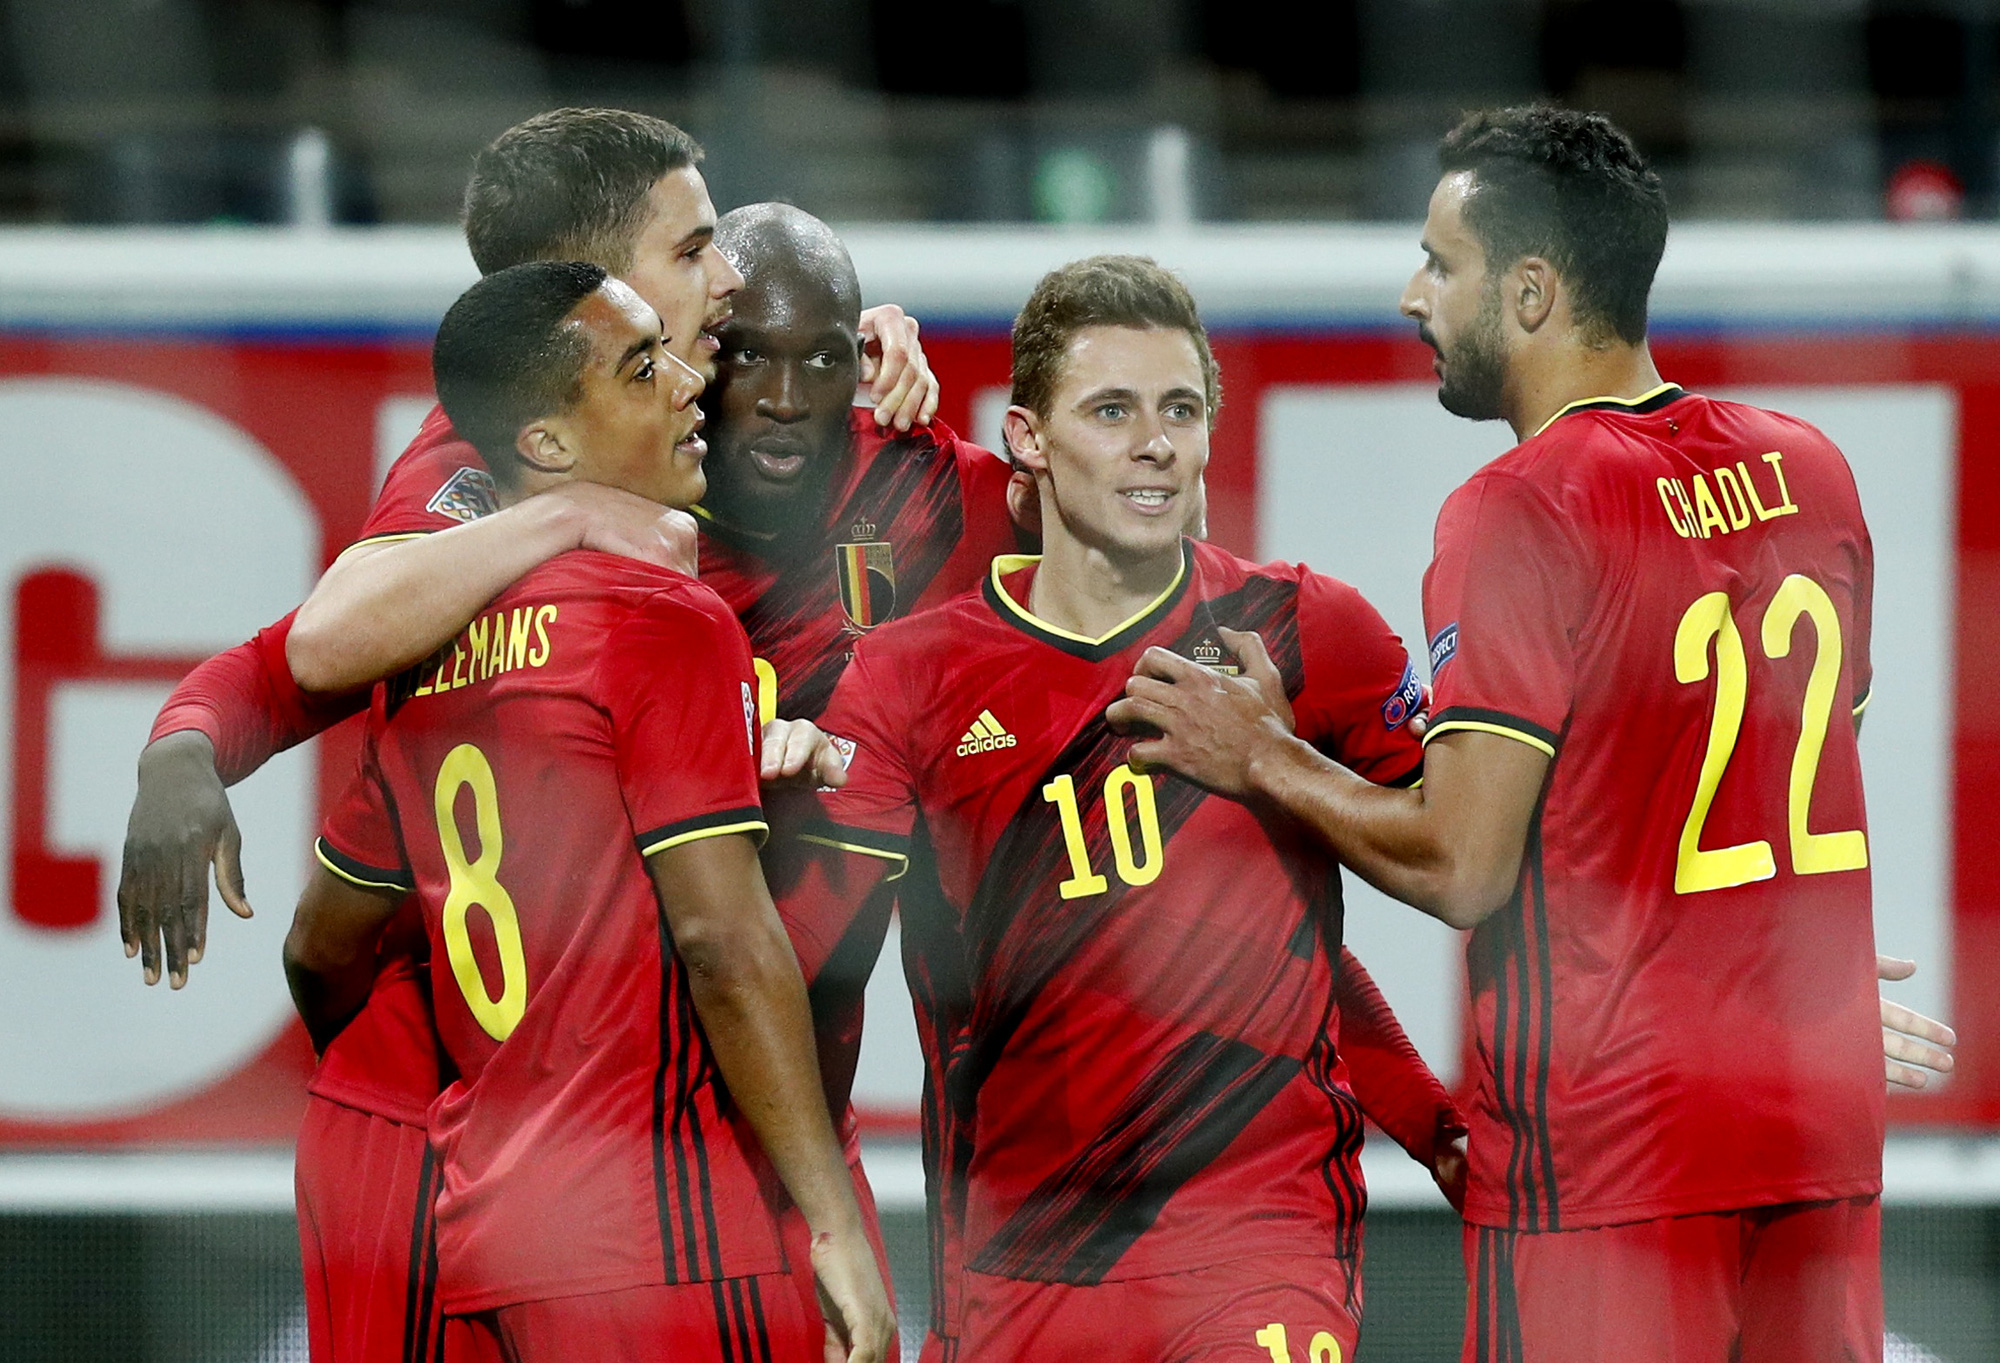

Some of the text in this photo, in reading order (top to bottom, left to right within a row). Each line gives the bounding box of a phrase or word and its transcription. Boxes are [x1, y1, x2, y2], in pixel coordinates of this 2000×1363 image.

[1656, 451, 1799, 539] CHADLI
[956, 733, 1017, 757] adidas
[1673, 573, 1869, 895] 22
[434, 742, 528, 1042] 8
[1042, 763, 1164, 900] 10
